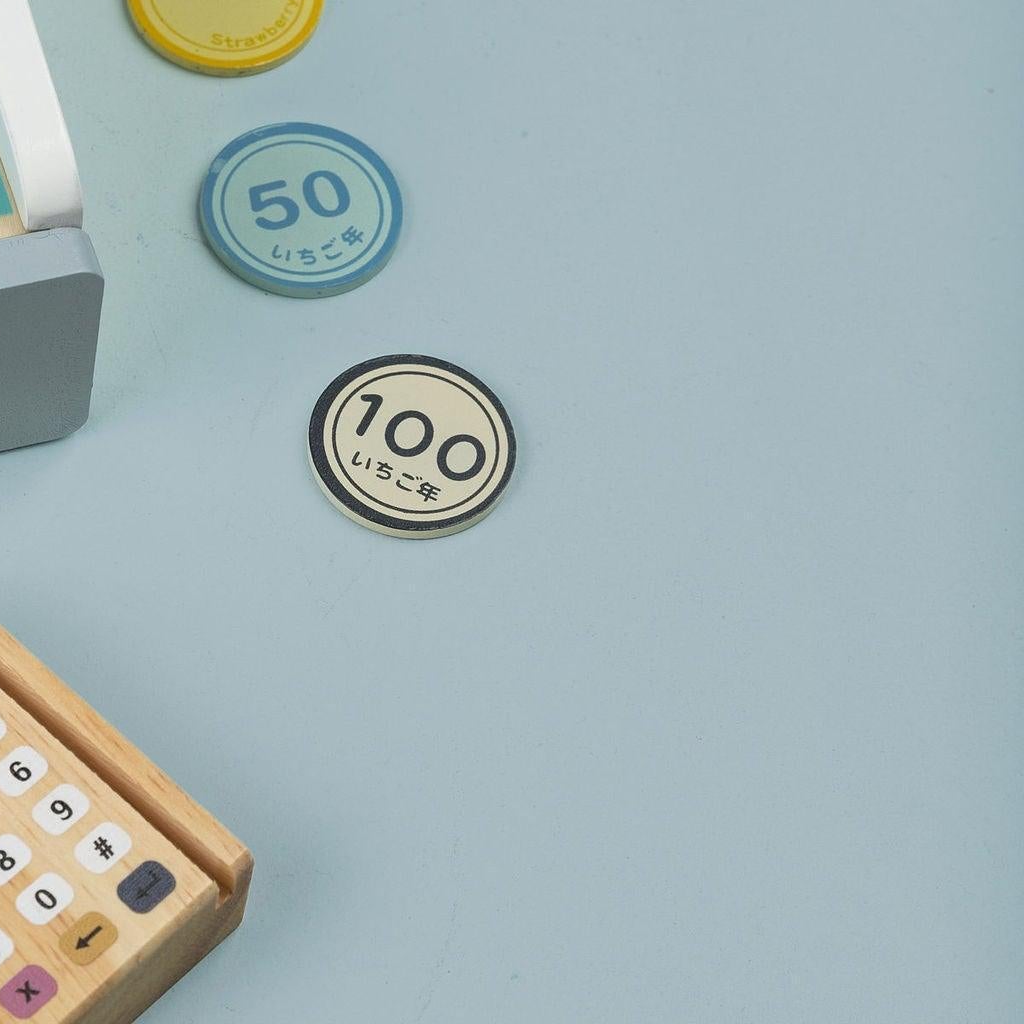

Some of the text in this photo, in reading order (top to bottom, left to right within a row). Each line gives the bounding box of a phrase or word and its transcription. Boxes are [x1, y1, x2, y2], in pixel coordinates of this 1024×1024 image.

[248, 169, 351, 231] 50
[271, 225, 364, 265] いちご年
[355, 393, 487, 482] 100
[351, 451, 442, 503] いちご年
[9, 761, 32, 782] 6
[50, 800, 74, 822] 9
[93, 836, 115, 860] #
[34, 889, 58, 911] 0
